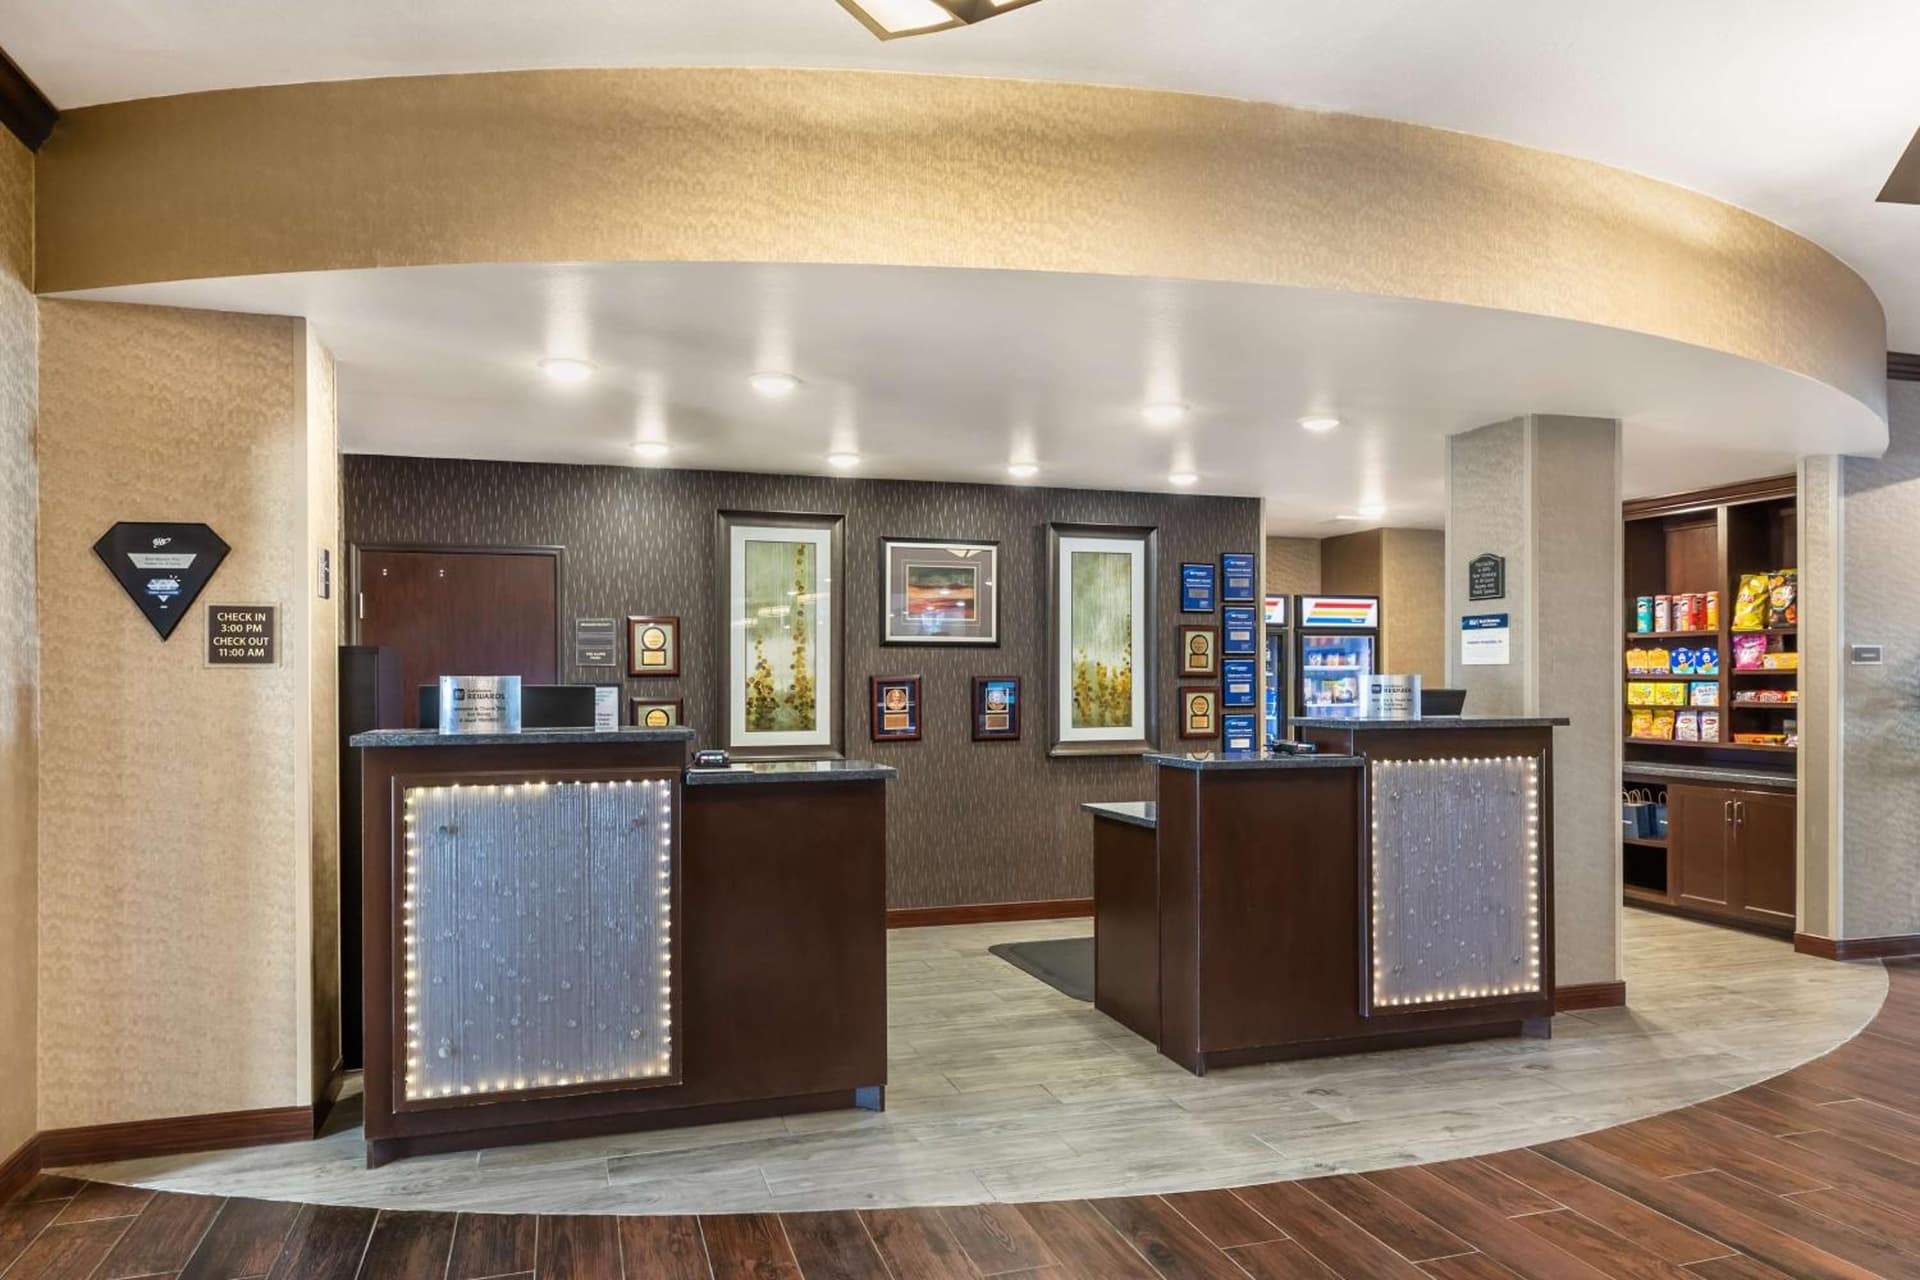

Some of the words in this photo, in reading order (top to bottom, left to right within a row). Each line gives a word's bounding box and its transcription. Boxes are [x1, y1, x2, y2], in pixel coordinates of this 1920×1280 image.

[216, 612, 252, 622] CHECK
[255, 612, 266, 622] IN
[220, 623, 243, 633] 3:00
[246, 623, 262, 633] PM
[213, 636, 247, 646] CHECK
[248, 636, 270, 646] OUT
[218, 648, 245, 657] 11:00
[247, 648, 265, 657] AM
